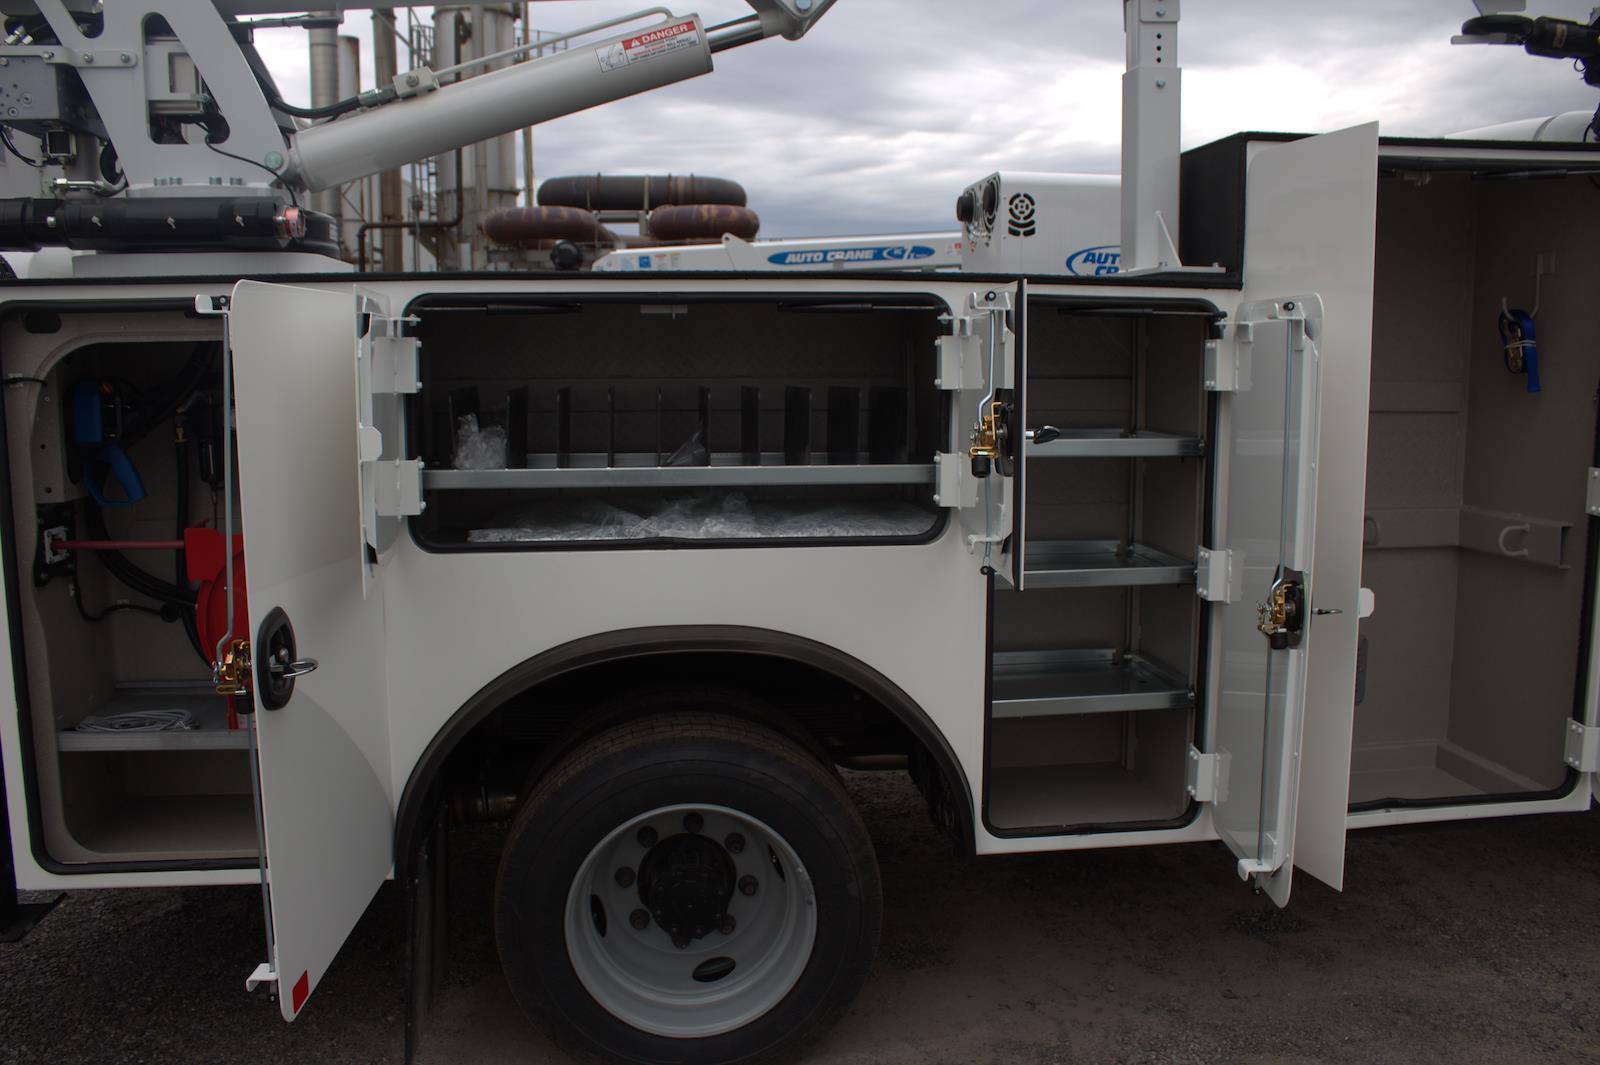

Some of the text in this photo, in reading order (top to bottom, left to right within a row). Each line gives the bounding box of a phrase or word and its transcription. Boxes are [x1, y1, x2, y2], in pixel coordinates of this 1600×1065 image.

[641, 23, 689, 43] DANGER
[785, 249, 874, 264] AUTO CRANE
[1082, 252, 1121, 265] AUT
